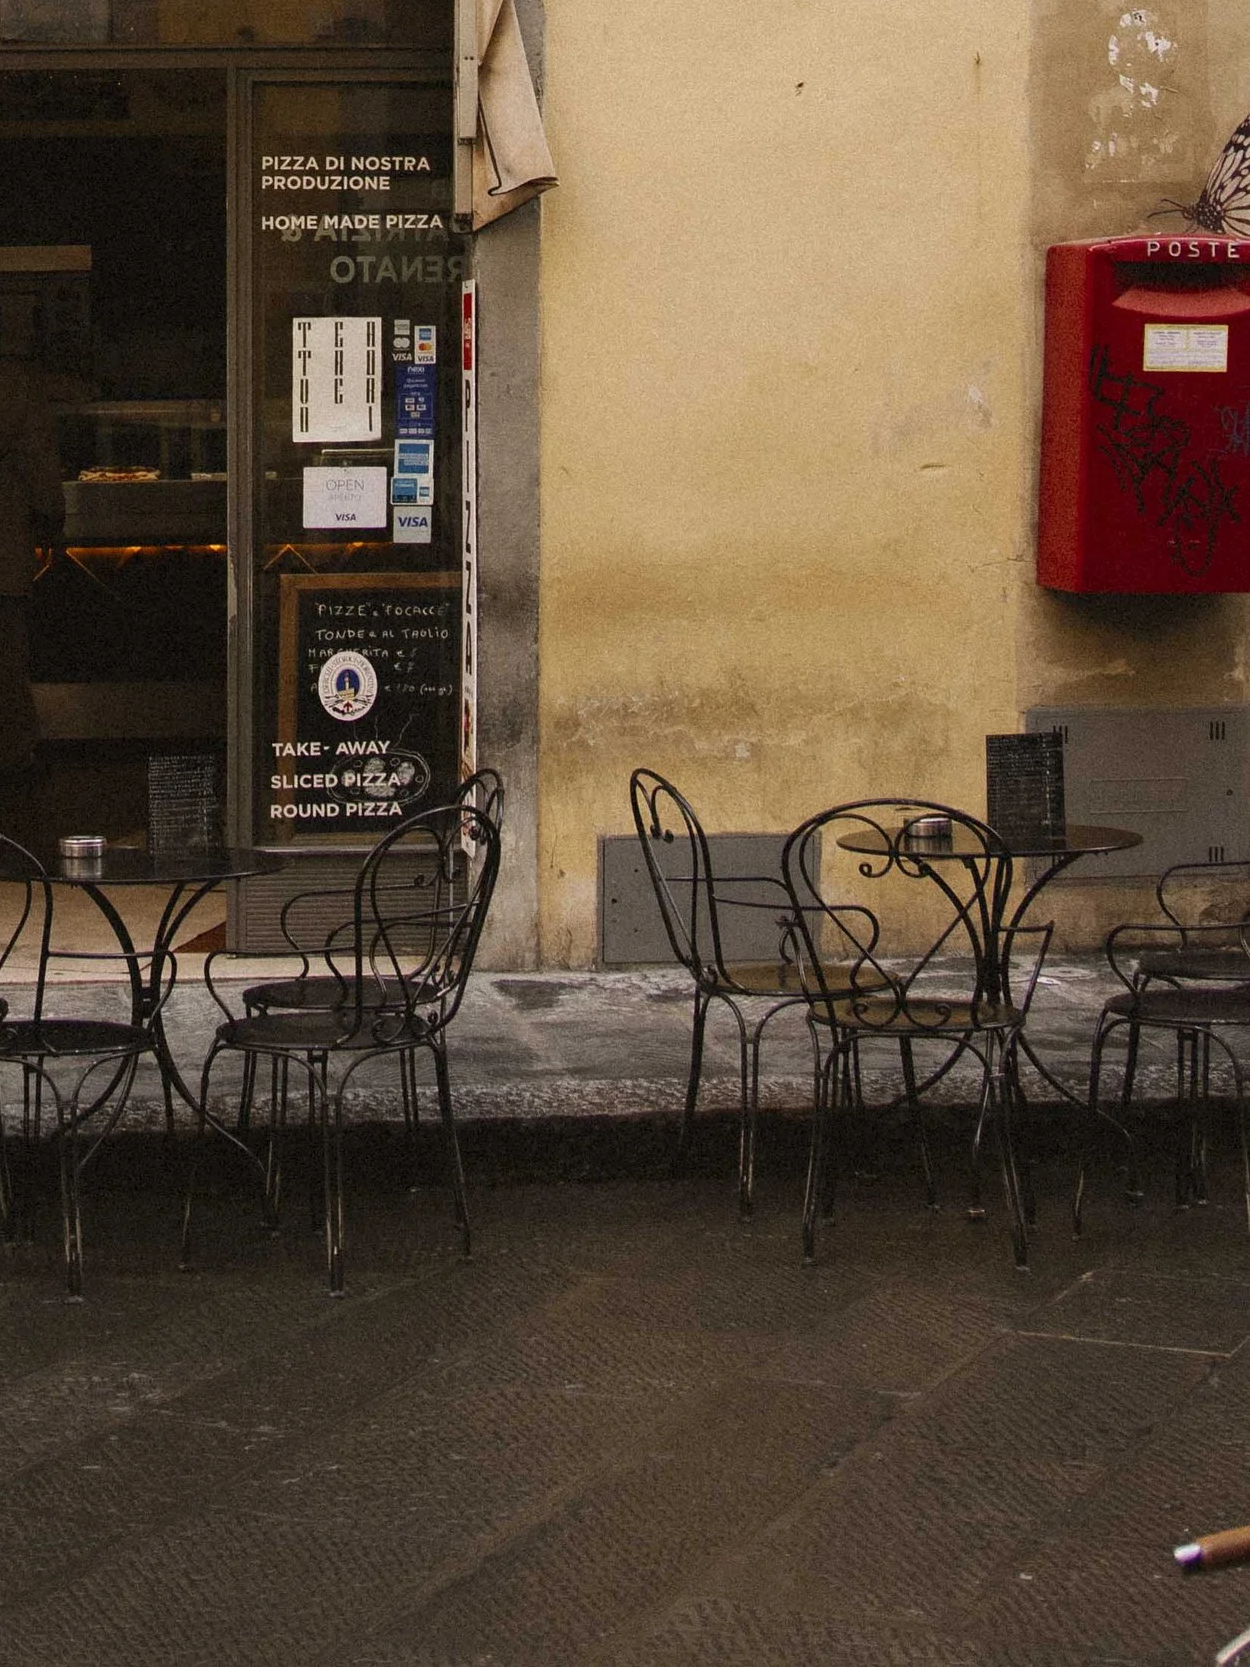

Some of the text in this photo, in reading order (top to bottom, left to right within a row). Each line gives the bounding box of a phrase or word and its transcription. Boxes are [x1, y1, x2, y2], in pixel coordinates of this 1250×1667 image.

[262, 156, 431, 171] PIZZA DI NOSTRA
[261, 176, 391, 191] PRODUZIONE
[261, 214, 444, 231] HOME MADE PIZZA
[1147, 241, 1239, 258] POSTE
[392, 353, 413, 362] VISA
[417, 355, 435, 363] VISA
[325, 479, 365, 492] OPEN
[335, 513, 357, 522] VISA
[397, 516, 429, 528] VISA
[315, 628, 366, 641] TONDE
[335, 740, 391, 755] AWAY
[270, 773, 402, 790] SLICED PIZZA
[270, 802, 403, 819] ROUND PIZZA
